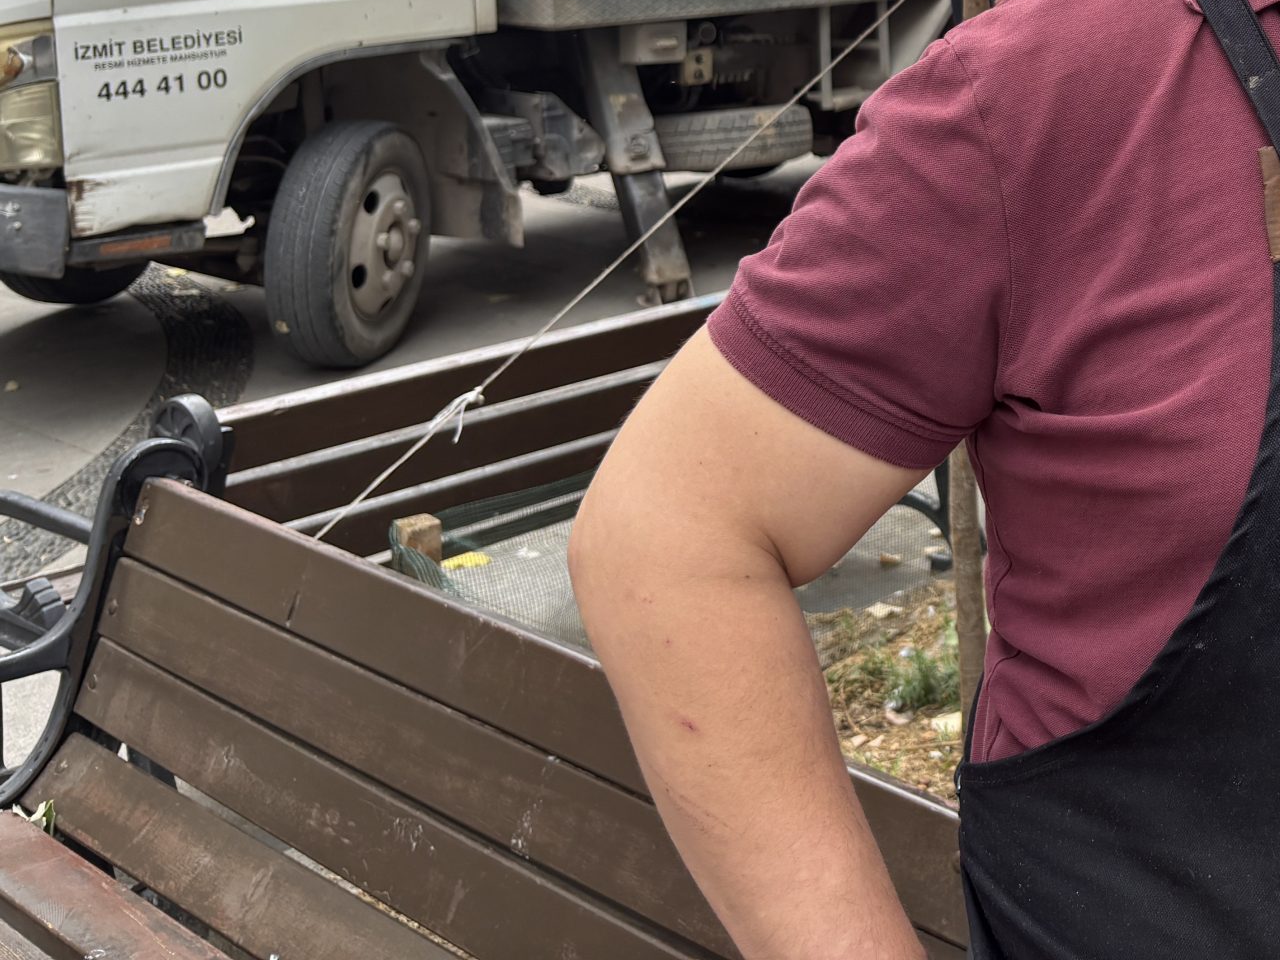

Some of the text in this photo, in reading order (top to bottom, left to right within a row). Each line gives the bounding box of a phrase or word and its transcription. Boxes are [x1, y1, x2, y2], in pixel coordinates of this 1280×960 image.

[74, 25, 243, 60] İZMİT BELEDİYESİ
[97, 68, 228, 102] 444 41 00
